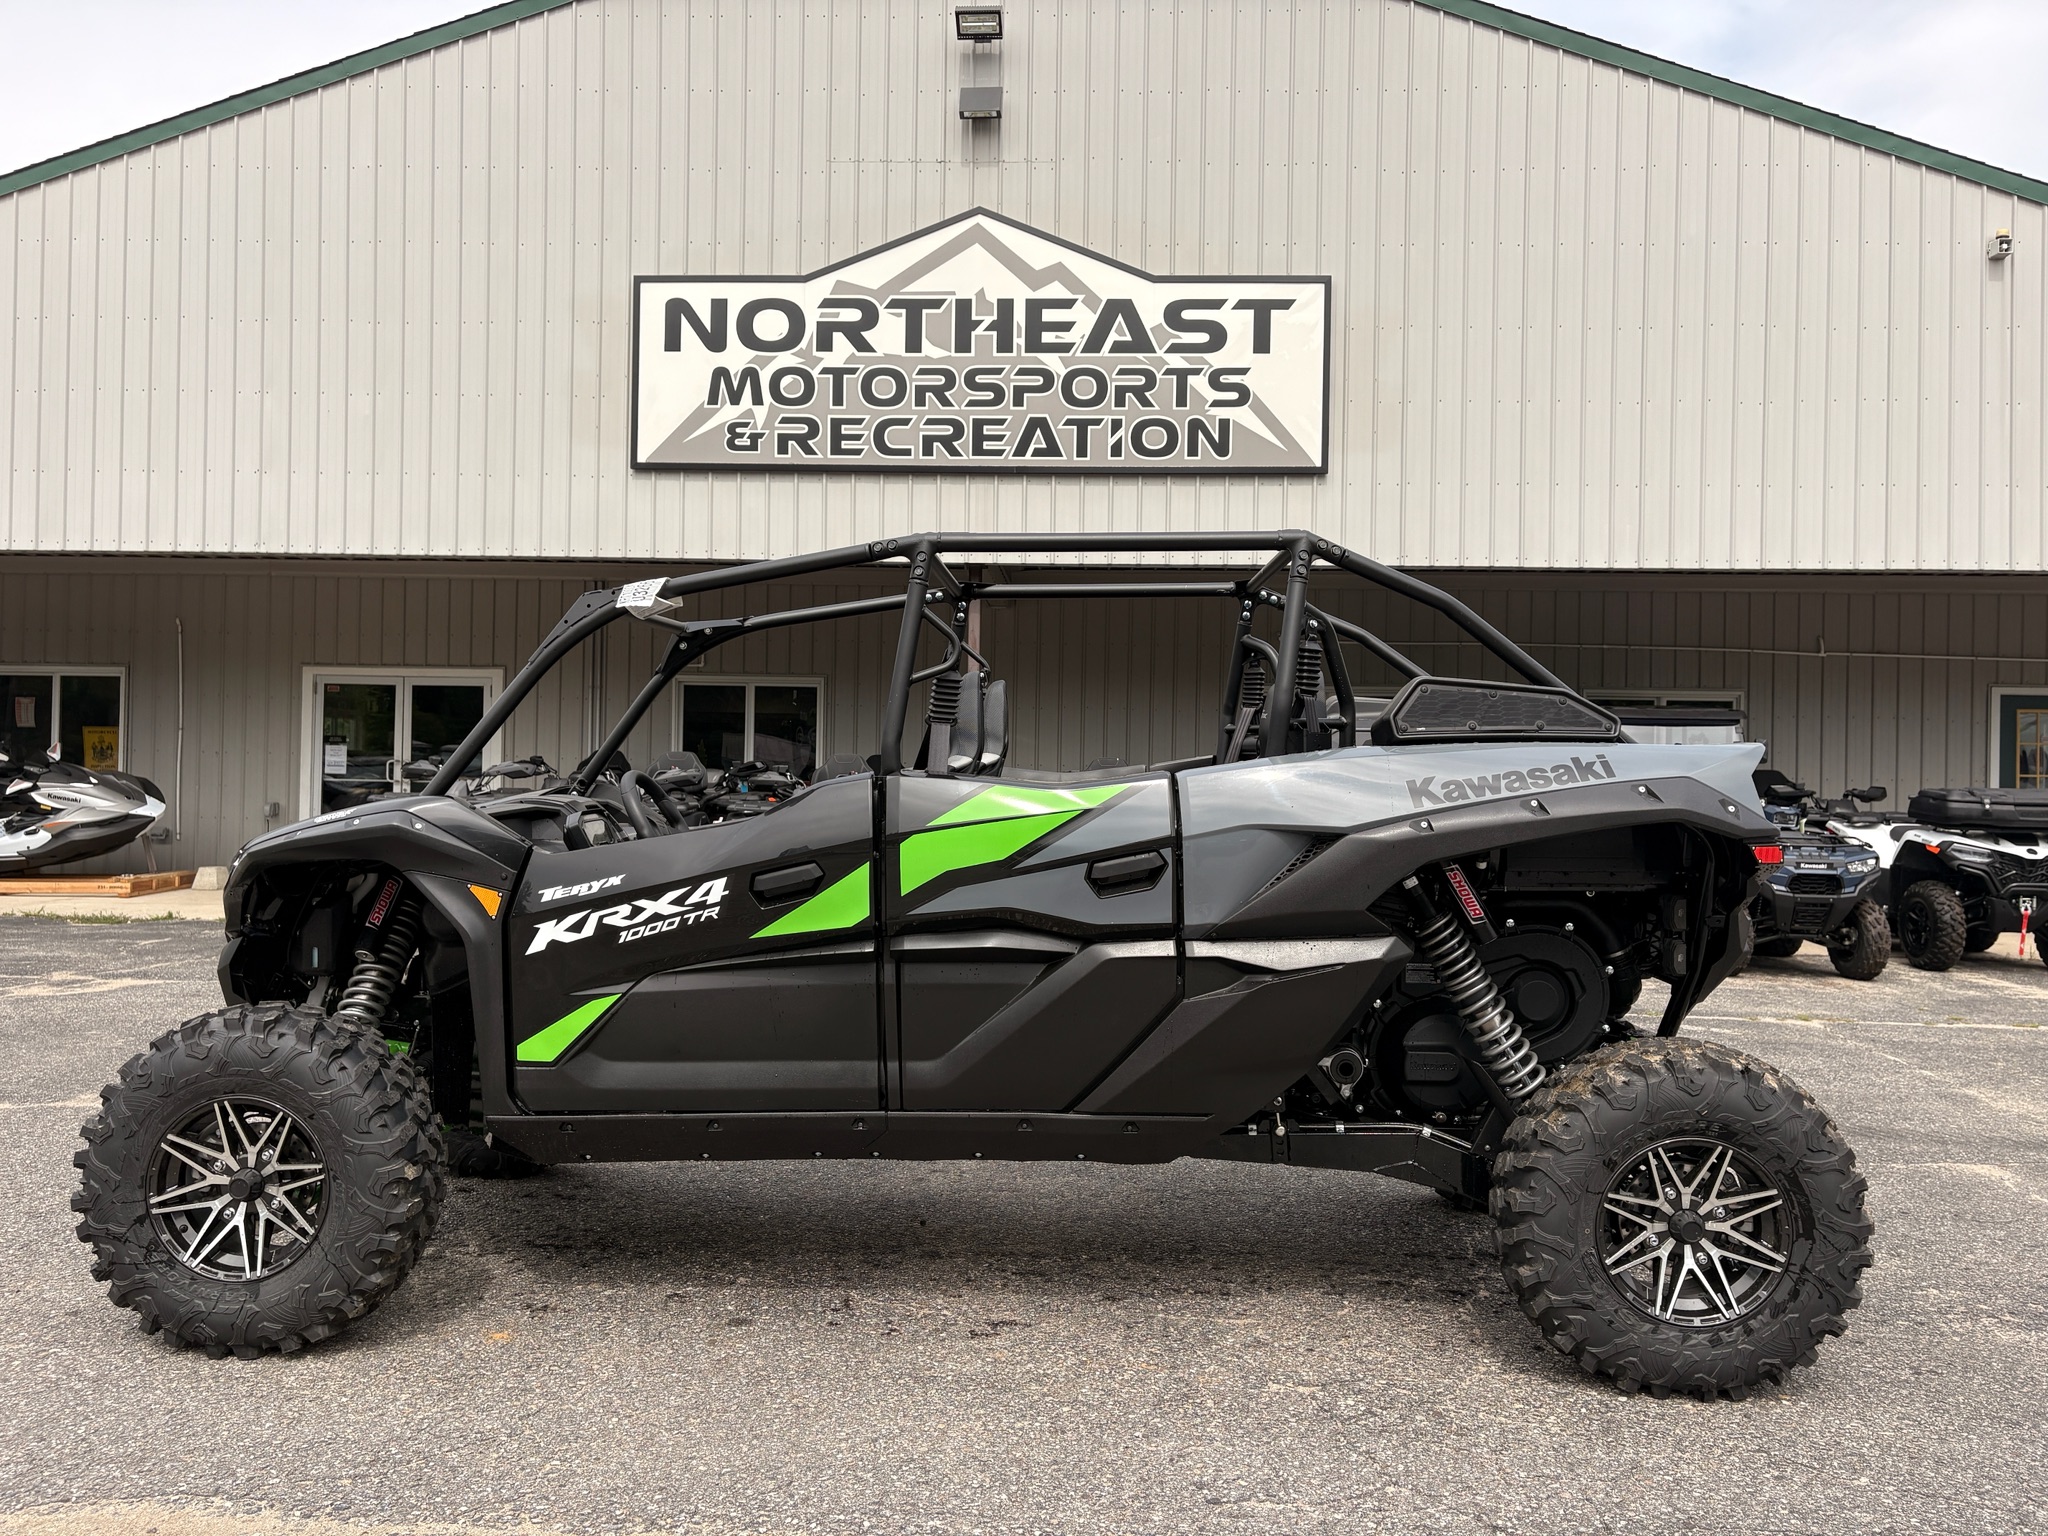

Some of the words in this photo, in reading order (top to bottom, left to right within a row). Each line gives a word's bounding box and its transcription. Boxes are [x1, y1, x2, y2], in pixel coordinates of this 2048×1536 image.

[664, 297, 1297, 354] NORTHEAST
[707, 366, 1251, 408] MOTORSPORTS
[777, 416, 1231, 458] RECREATION
[47, 792, 82, 804] Kawasaki
[1405, 754, 1617, 809] Kawasaki
[370, 879, 399, 926] SHOWA
[537, 873, 627, 903] TERYX
[1446, 870, 1485, 919] SHOWA
[524, 876, 730, 956] KRX4
